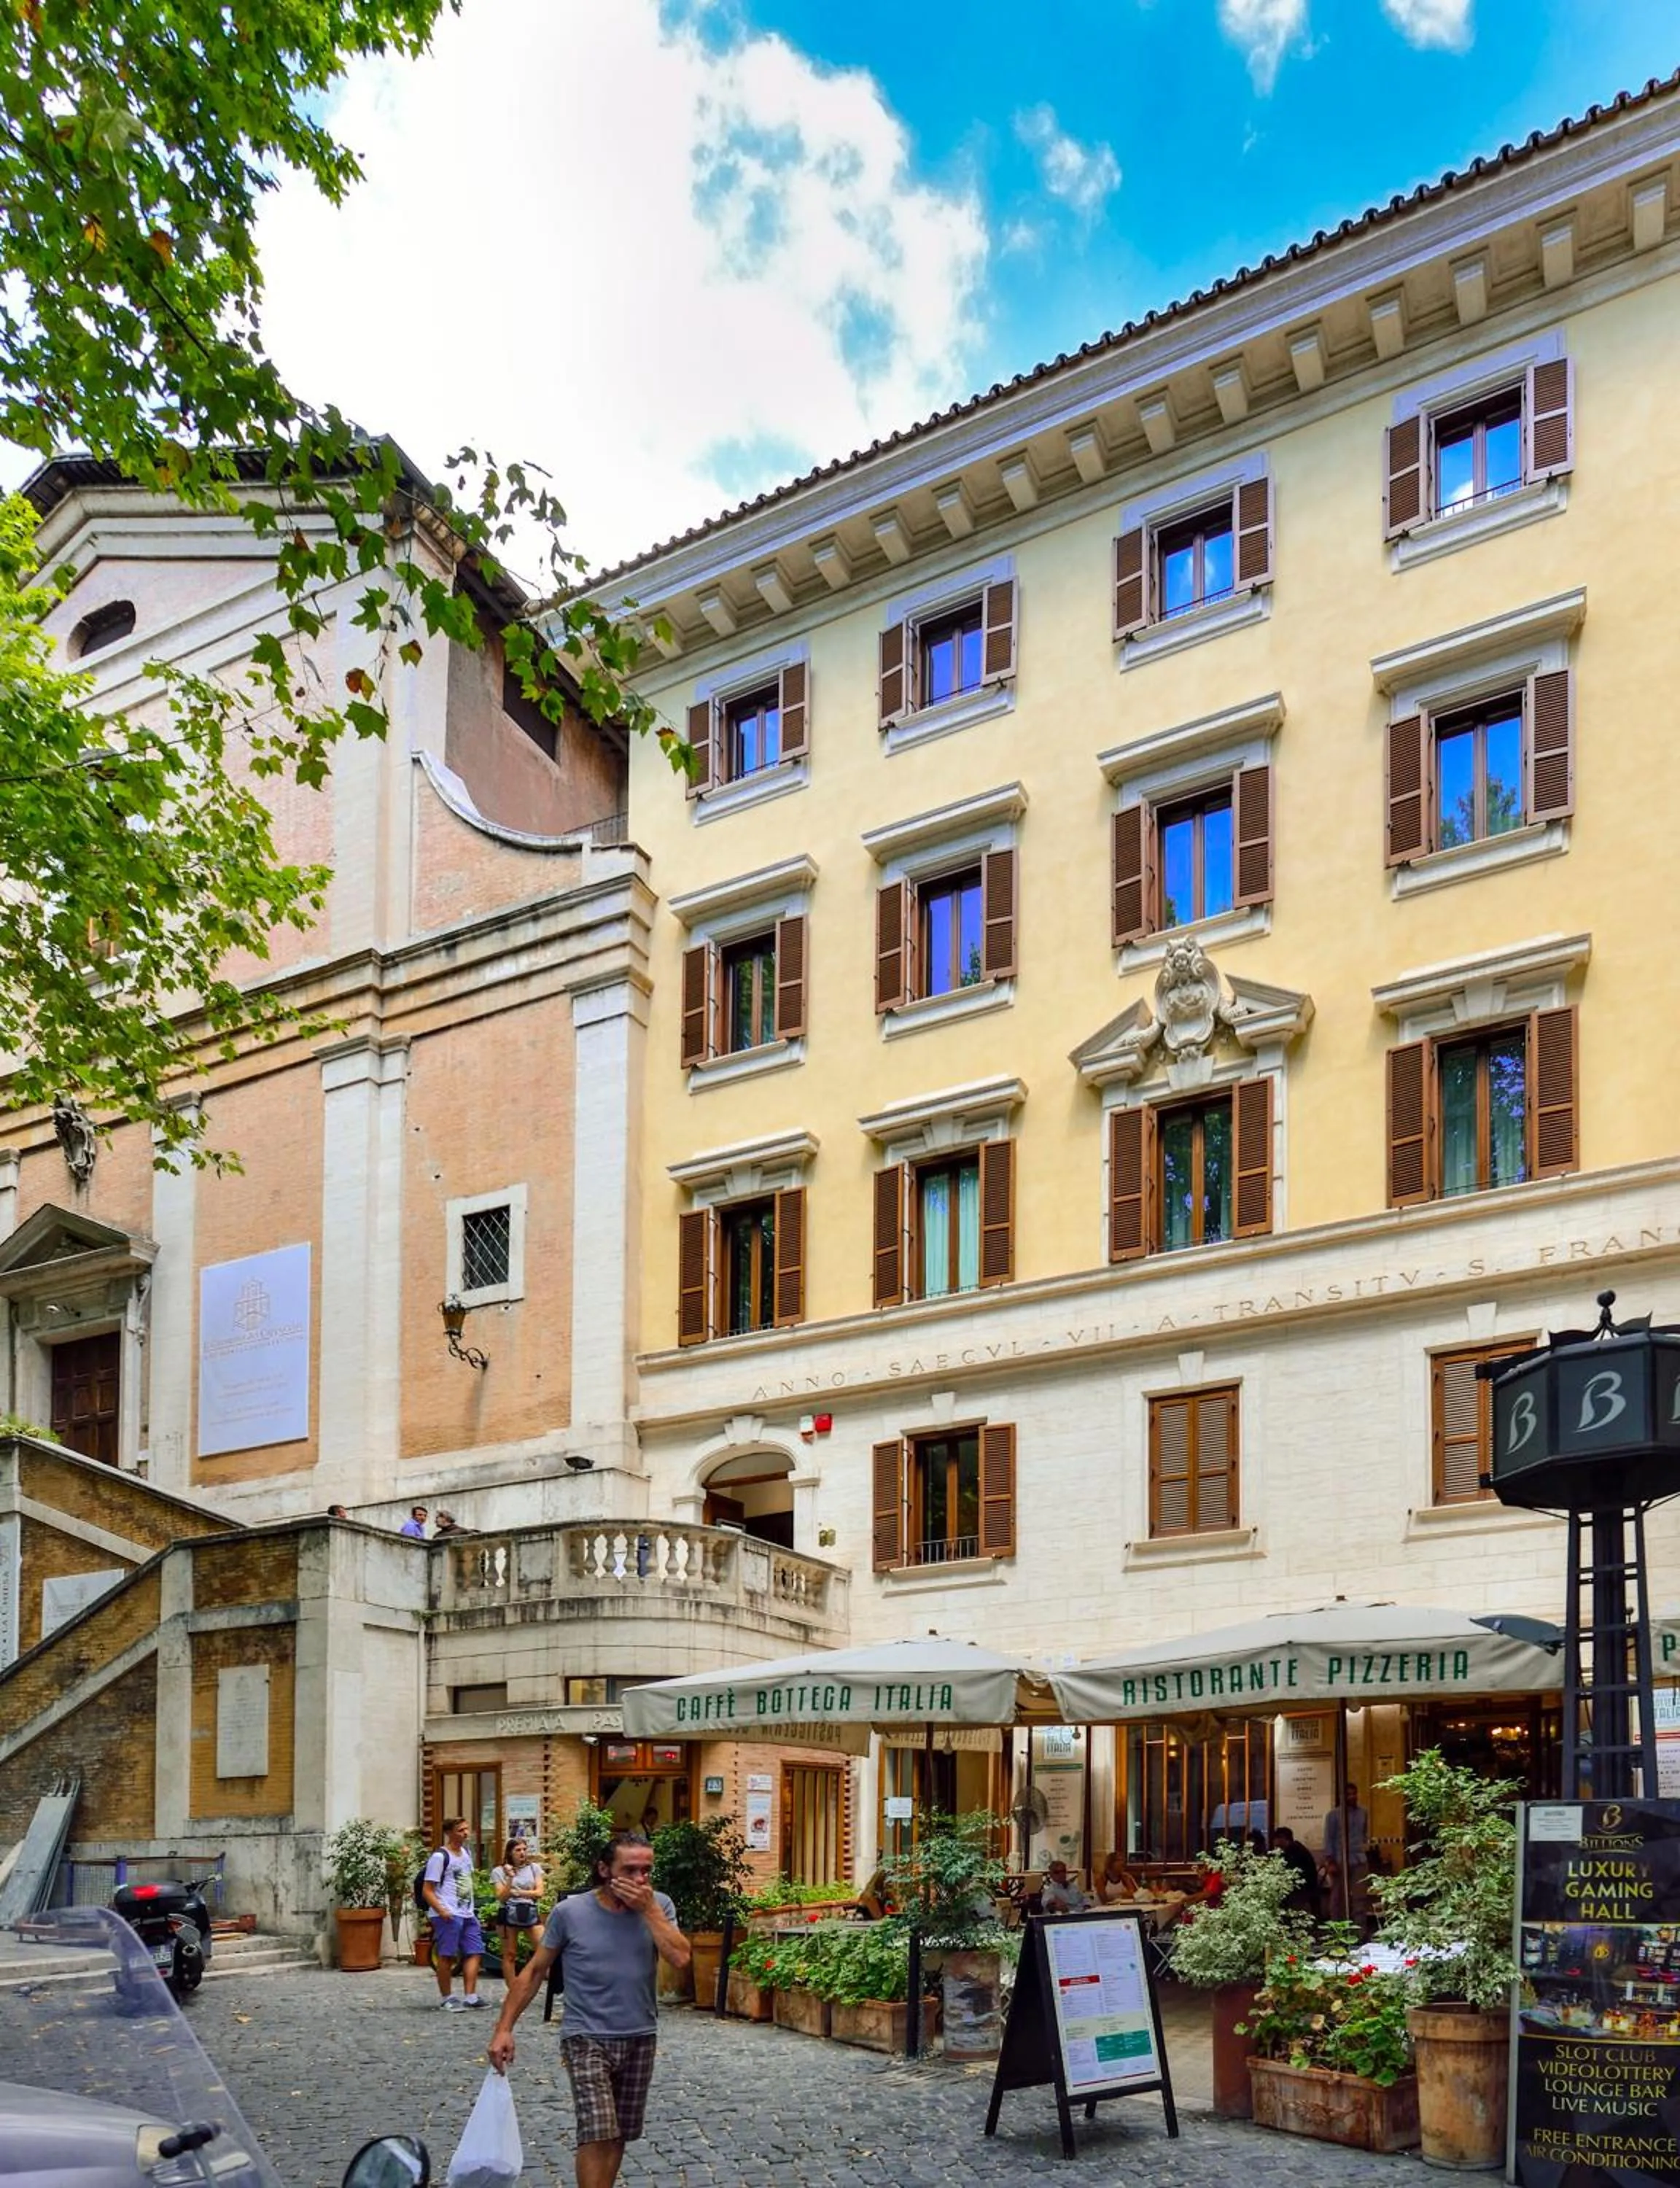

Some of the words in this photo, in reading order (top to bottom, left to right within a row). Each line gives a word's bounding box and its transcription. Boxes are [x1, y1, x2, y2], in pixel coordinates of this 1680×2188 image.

[752, 1372, 846, 1401] ANNO
[888, 1340, 1025, 1377] SAECVL
[1067, 1323, 1116, 1343] VII
[1157, 1315, 1176, 1332] A
[1213, 1270, 1421, 1322] TRANSITV
[1539, 1226, 1680, 1265] FRAN
[1122, 1658, 1299, 1706] RISTORANTE
[1328, 1650, 1469, 1685] PIZZERIA
[676, 1688, 736, 1722] CAFFÈ
[756, 1685, 852, 1716] BOTTEGA
[875, 1684, 952, 1712] ITALIA
[1579, 1835, 1645, 1850] BILLIONS
[1568, 1861, 1651, 1879] LUXURY
[1566, 1882, 1654, 1899] GAMING
[1580, 1903, 1636, 1920] HALL
[1555, 2044, 1601, 2061] SLOT
[1606, 2049, 1657, 2063] CLUB
[1537, 2060, 1676, 2082] VIDEOLOTTERY
[1544, 2079, 1624, 2098] LOUNGE
[1630, 2084, 1667, 2099] BAR
[1552, 2096, 1588, 2113] LIVE
[1593, 2101, 1657, 2117] MUSIC
[1533, 2127, 1571, 2146] FREE
[1576, 2133, 1677, 2152] ENTRANCE
[1525, 2144, 1547, 2159] AIR
